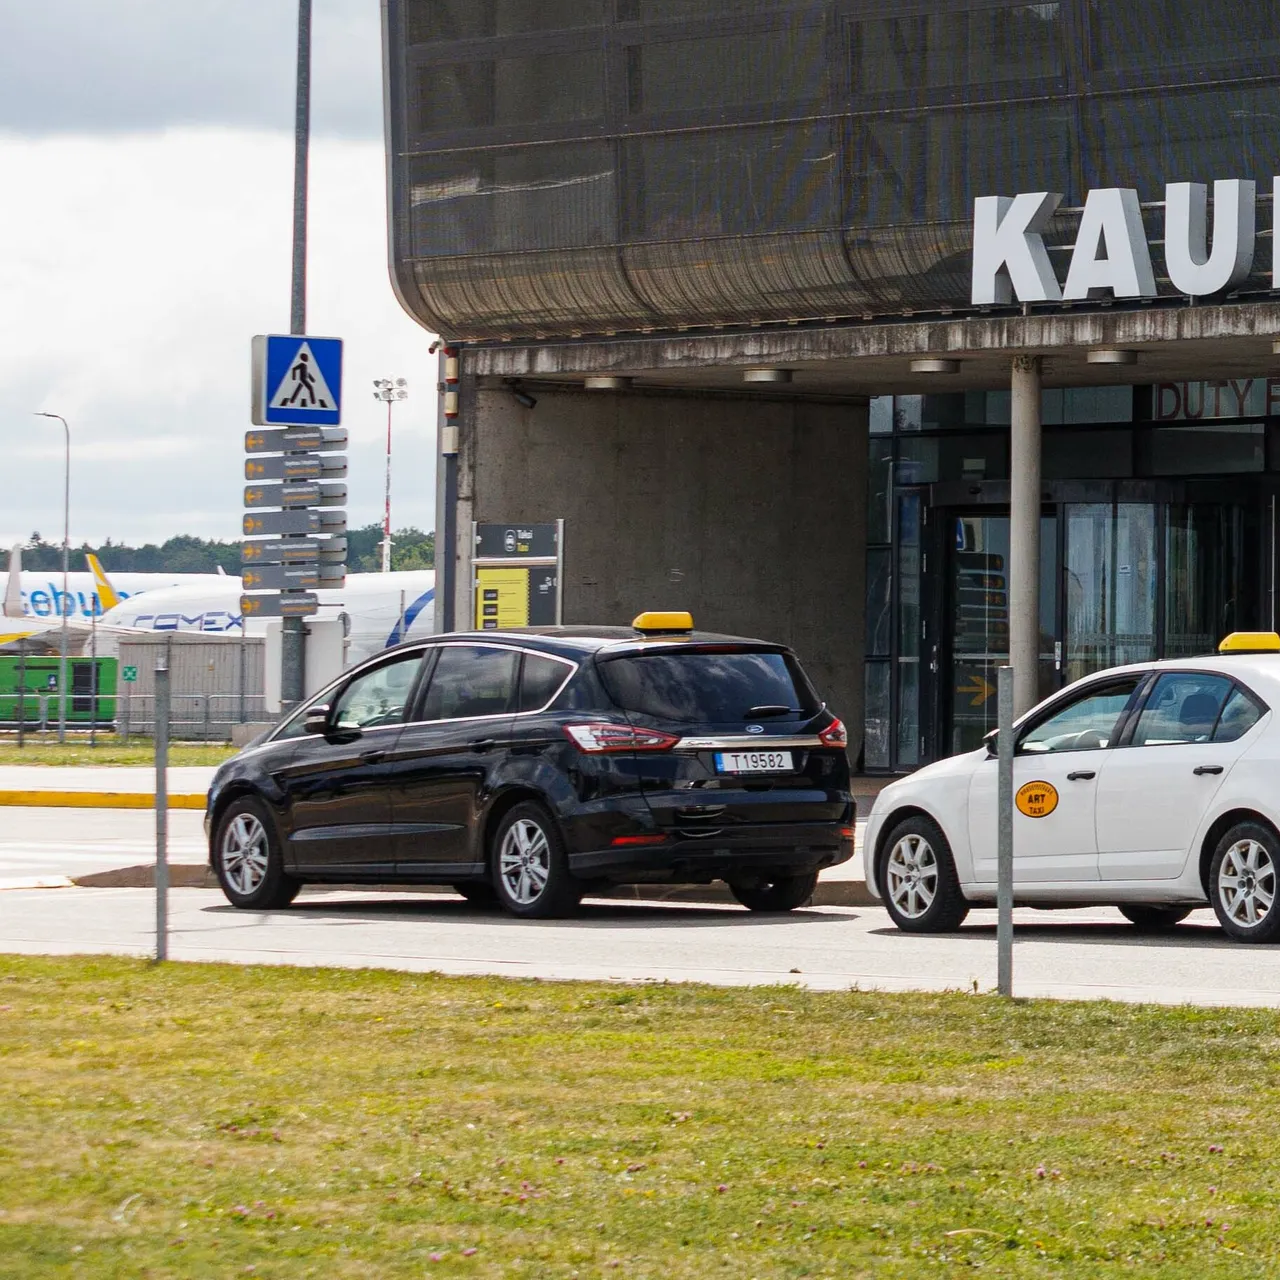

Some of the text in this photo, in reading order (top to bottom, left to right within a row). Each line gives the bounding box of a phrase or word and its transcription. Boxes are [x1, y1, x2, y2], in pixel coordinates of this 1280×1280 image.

[1156, 378, 1254, 419] DUTY
[731, 753, 784, 769] T19582
[1028, 794, 1045, 804] ART
